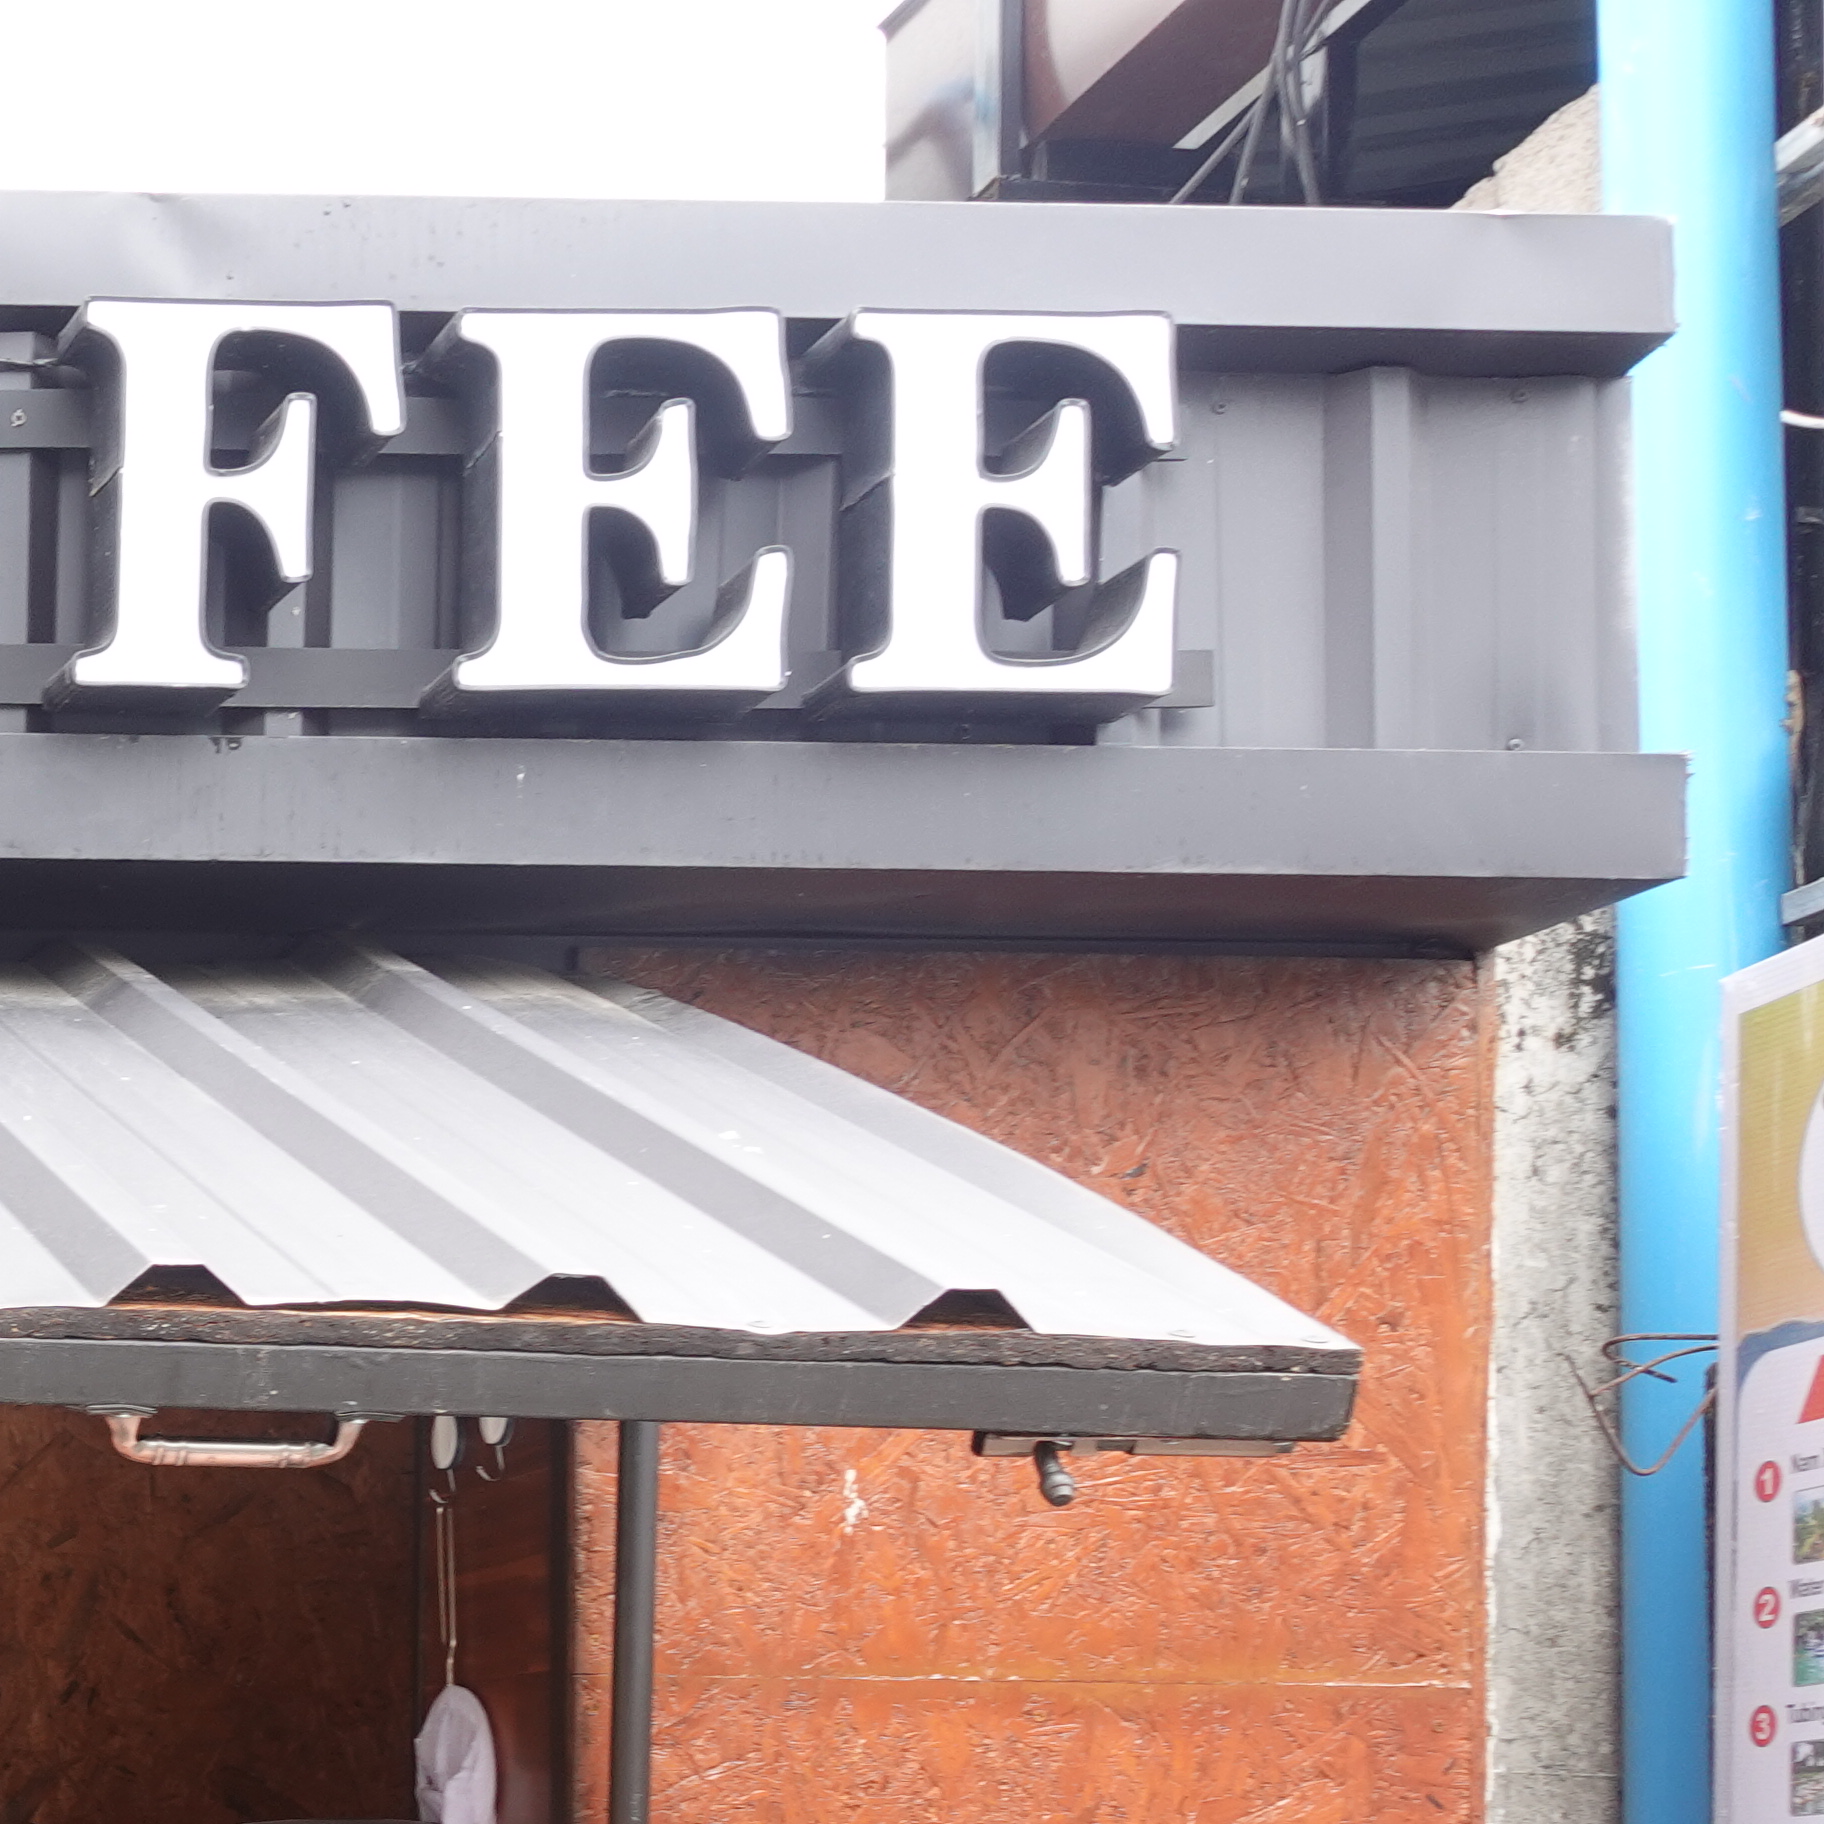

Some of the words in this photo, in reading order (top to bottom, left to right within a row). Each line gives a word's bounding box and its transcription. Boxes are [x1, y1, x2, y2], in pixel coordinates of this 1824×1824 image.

[1759, 1467, 1776, 1496] 1
[1758, 1595, 1777, 1623] 2
[1755, 1712, 1772, 1740] 3
